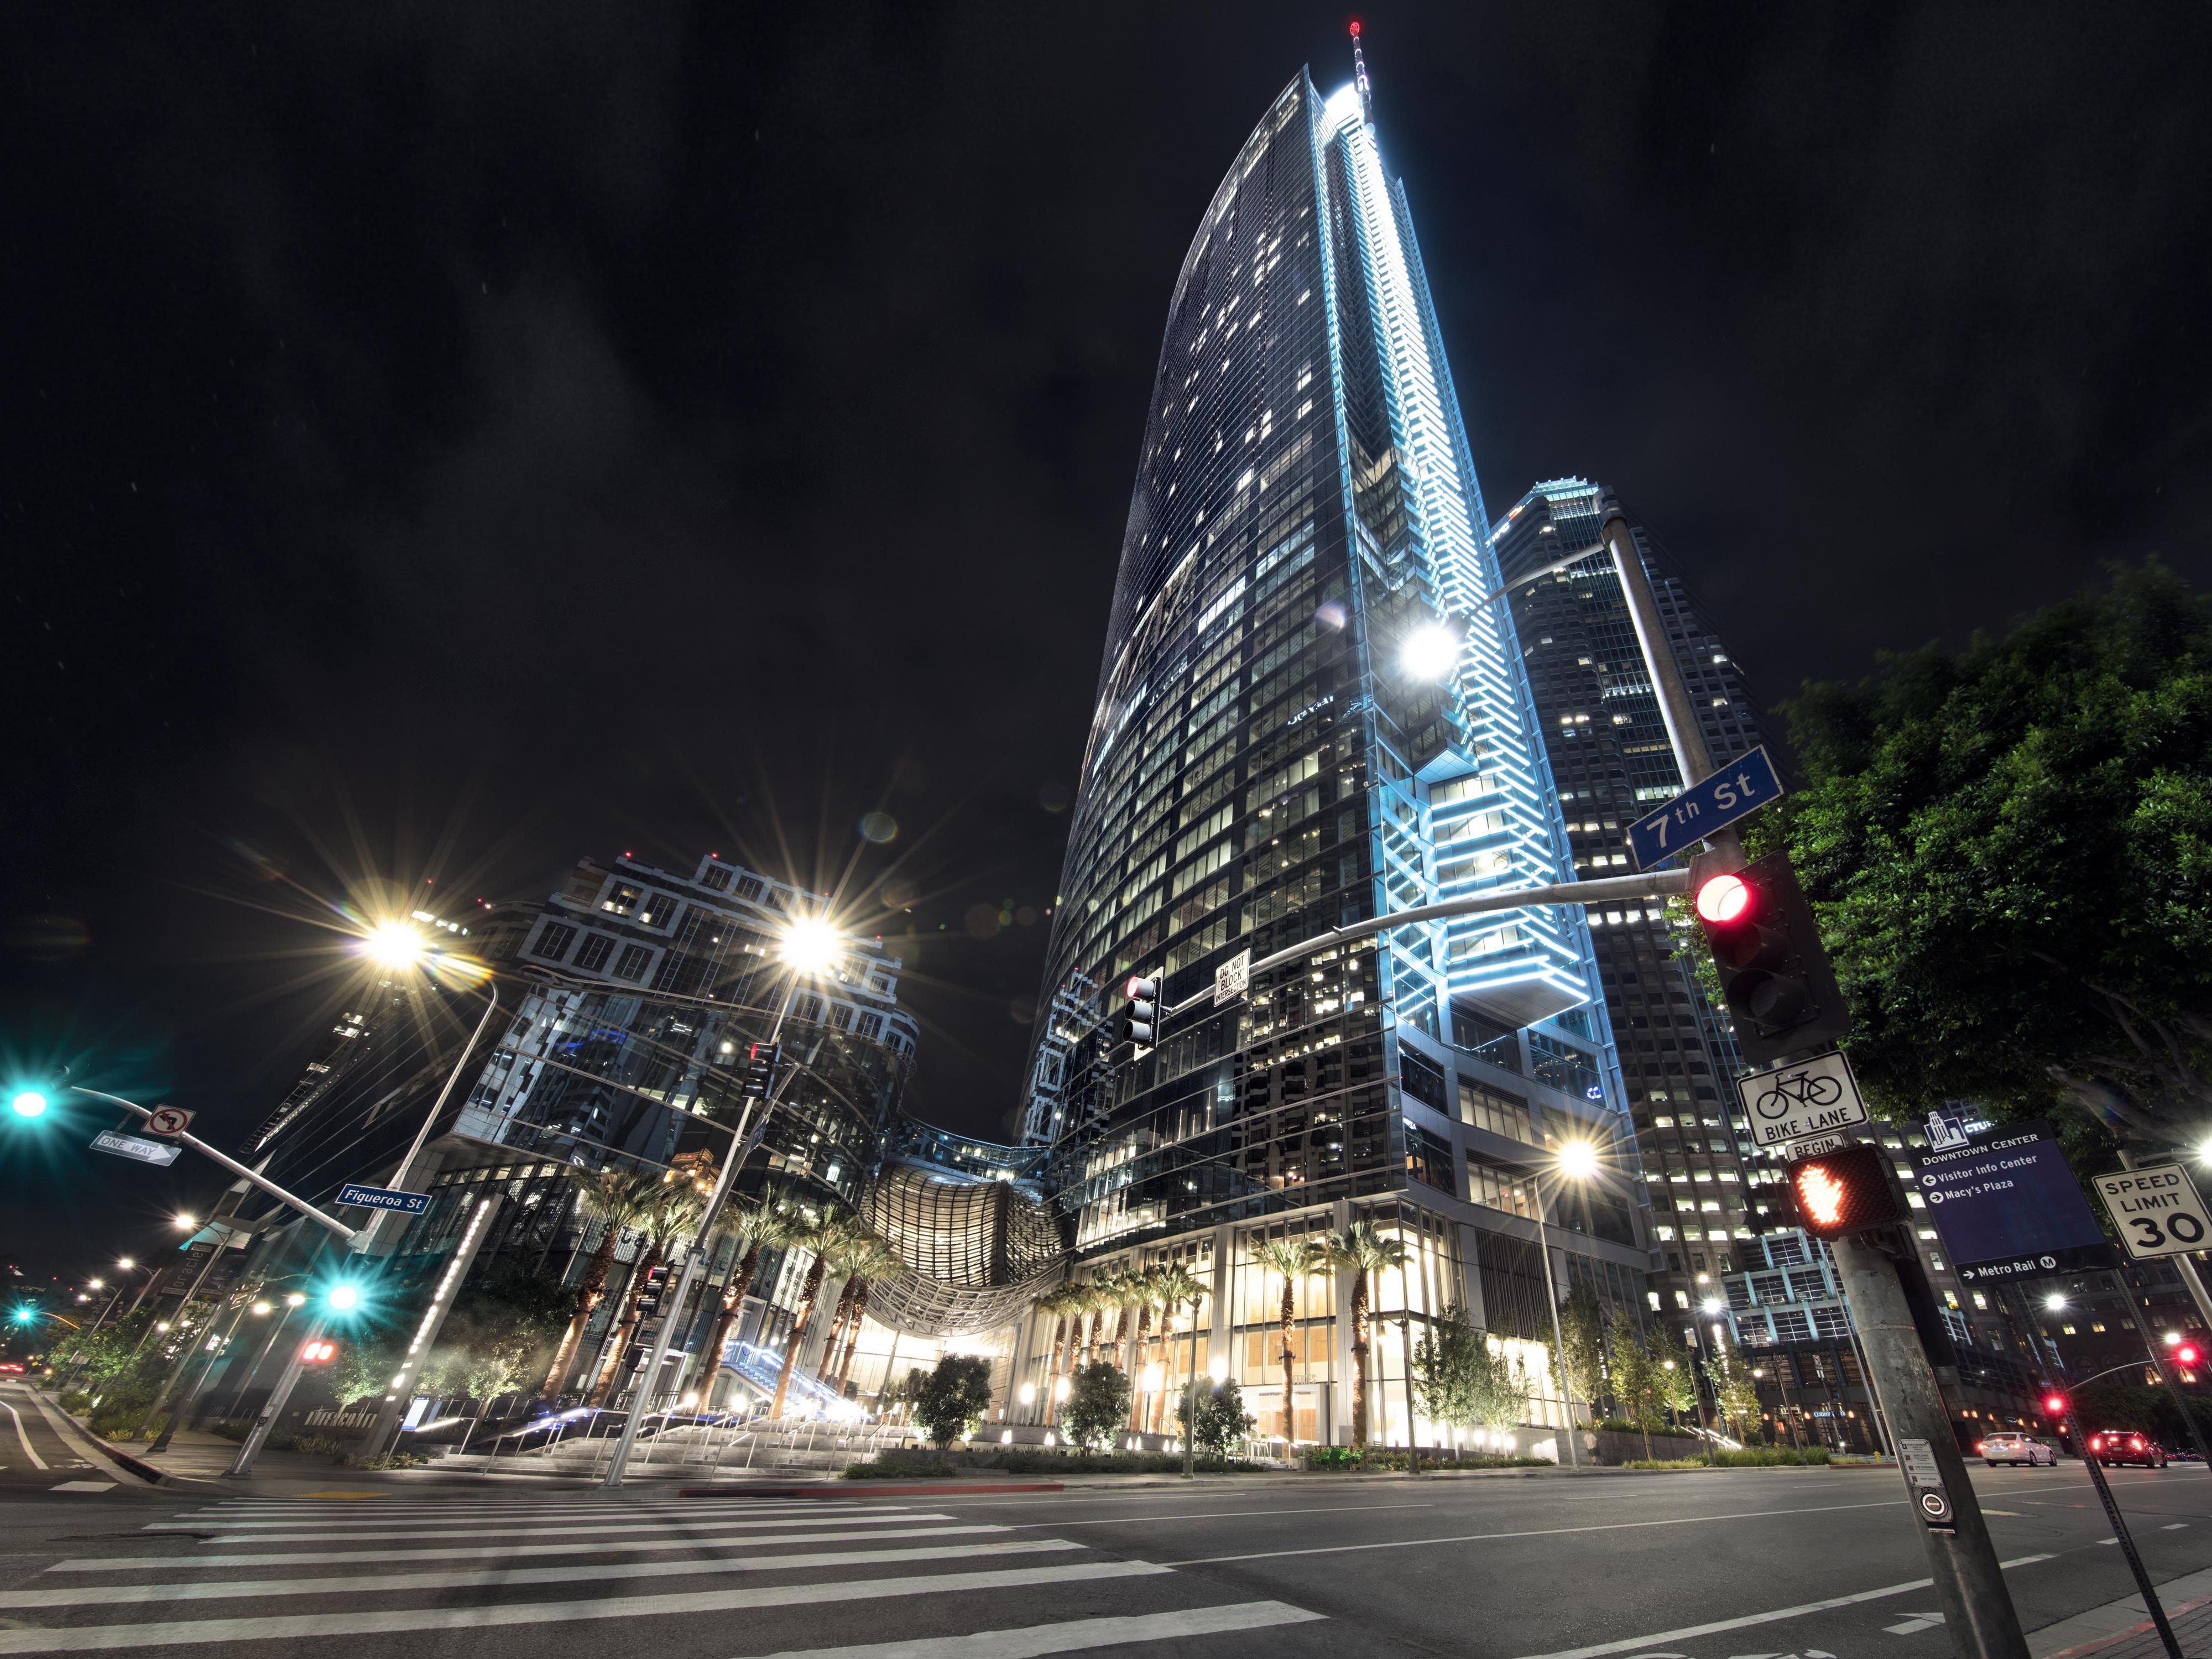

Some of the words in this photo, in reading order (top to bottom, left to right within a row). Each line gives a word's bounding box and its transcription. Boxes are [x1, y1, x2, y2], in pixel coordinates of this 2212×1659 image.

[1646, 801, 1700, 848] 7th
[1714, 773, 1755, 810] St
[1220, 966, 1229, 979] DO
[1232, 955, 1245, 972] NOT
[1216, 979, 1246, 1003] INTERSECTION
[1221, 969, 1242, 991] BLOCK
[1765, 1120, 1801, 1140] BIKE
[1808, 1108, 1851, 1130] LANE
[102, 1137, 127, 1149] ONE
[131, 1144, 157, 1155] WAY
[1794, 1139, 1835, 1160] BEGIN
[1922, 1145, 1989, 1166] DOWNTOWN
[1991, 1134, 2039, 1150] CENTER
[1938, 1169, 1973, 1183] Visitor
[1975, 1164, 1998, 1175] Info
[2000, 1156, 2037, 1170] Center
[1945, 1186, 1981, 1200] Macy's
[1983, 1180, 2014, 1192] Plaza
[2105, 1173, 2180, 1195] SPEED
[345, 1190, 403, 1206] Figueroa
[406, 1198, 422, 1209] St
[2120, 1192, 2180, 1213] LIMIT
[2129, 1212, 2204, 1248] 30
[1978, 1265, 2012, 1277] Metro
[2013, 1260, 2036, 1272] Rail
